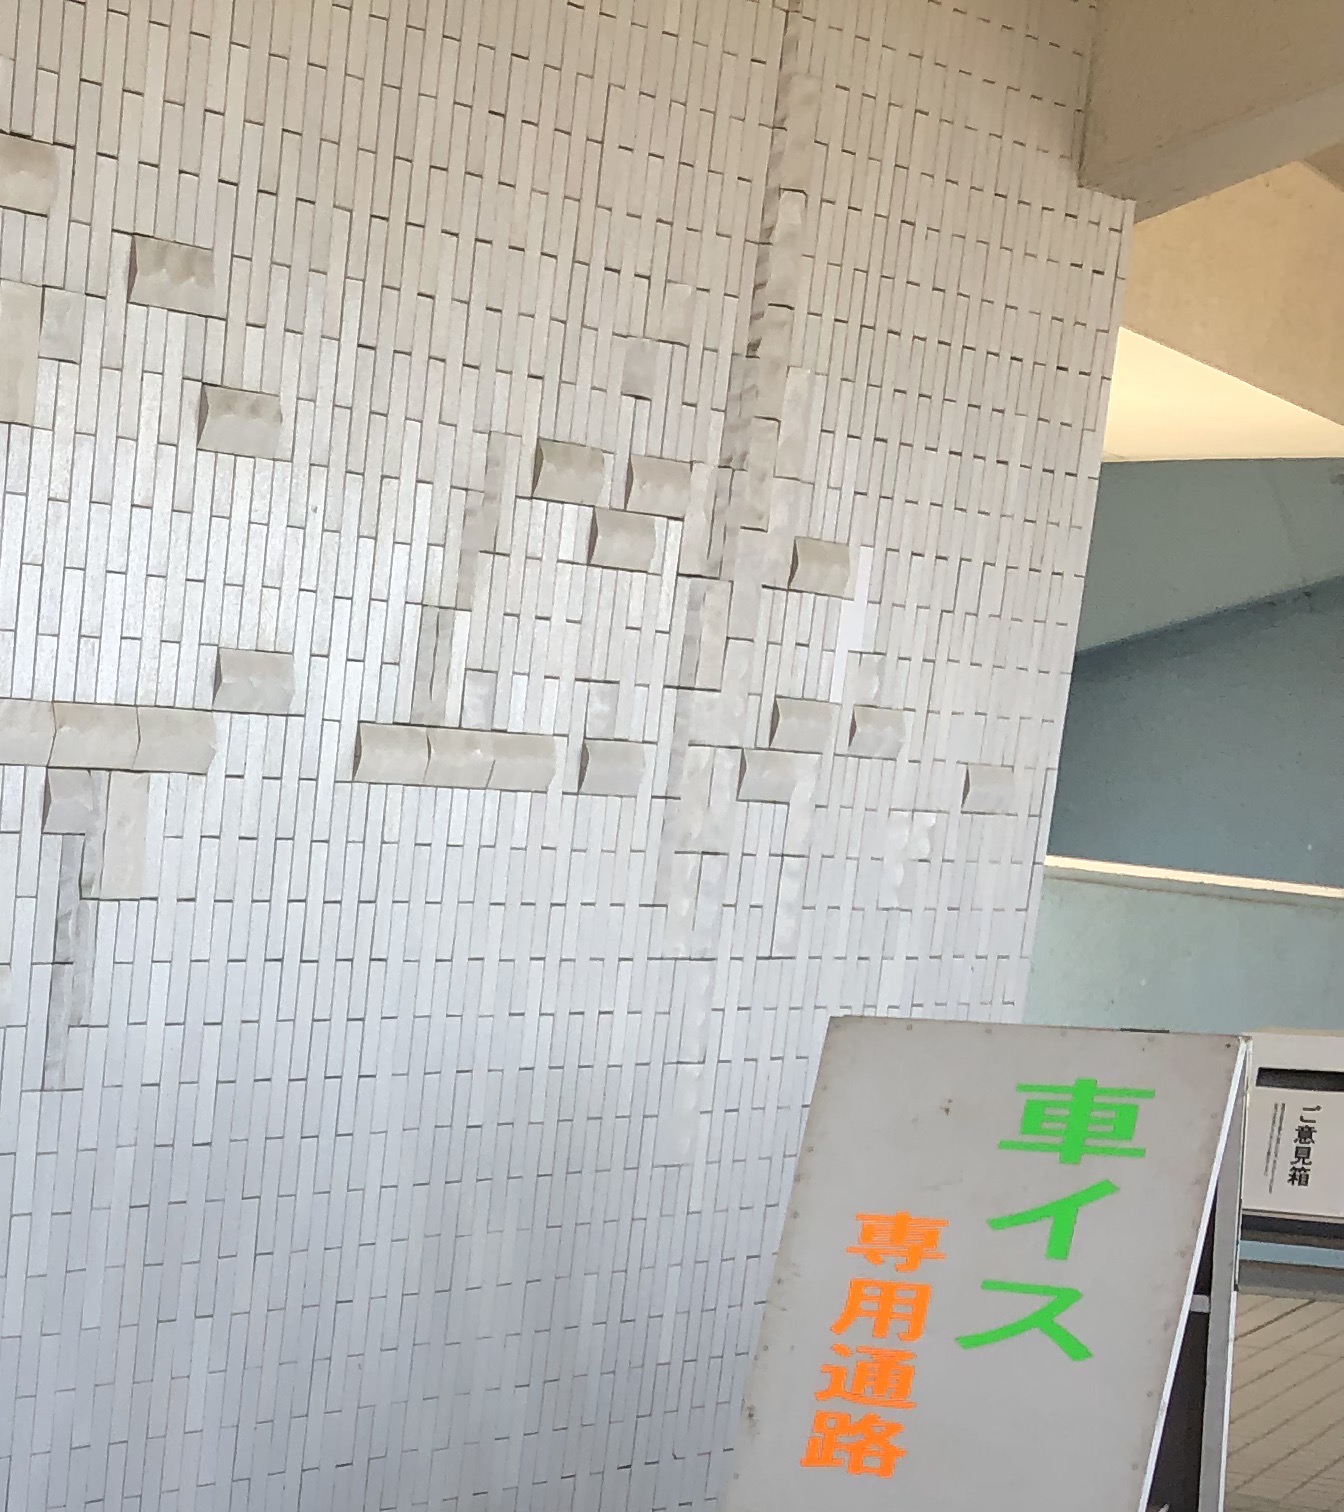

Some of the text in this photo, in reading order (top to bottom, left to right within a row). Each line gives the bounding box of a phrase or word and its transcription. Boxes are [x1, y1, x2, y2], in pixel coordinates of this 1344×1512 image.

[955, 1078, 1156, 1362] 車イス
[1287, 1104, 1322, 1187] ご意見箱
[800, 1211, 949, 1478] 専用通路
